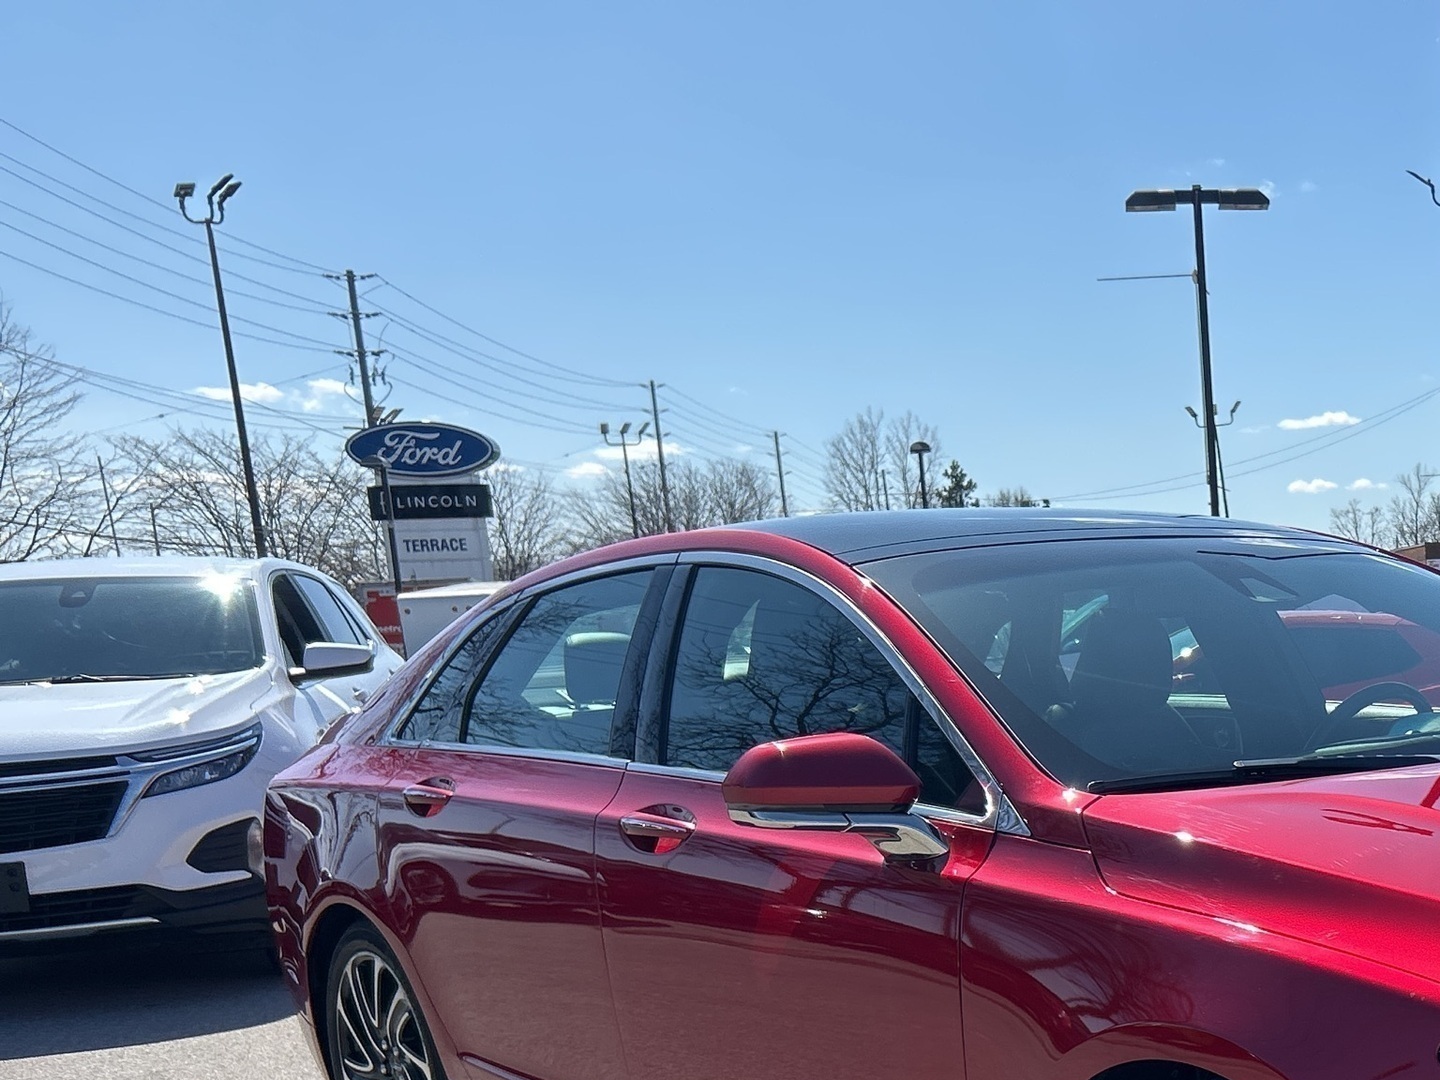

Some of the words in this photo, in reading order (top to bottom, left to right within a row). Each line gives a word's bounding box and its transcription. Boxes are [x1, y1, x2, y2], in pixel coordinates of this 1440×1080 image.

[377, 430, 463, 466] Ford
[396, 494, 478, 509] LINCOLN
[402, 538, 468, 553] TERRACE
